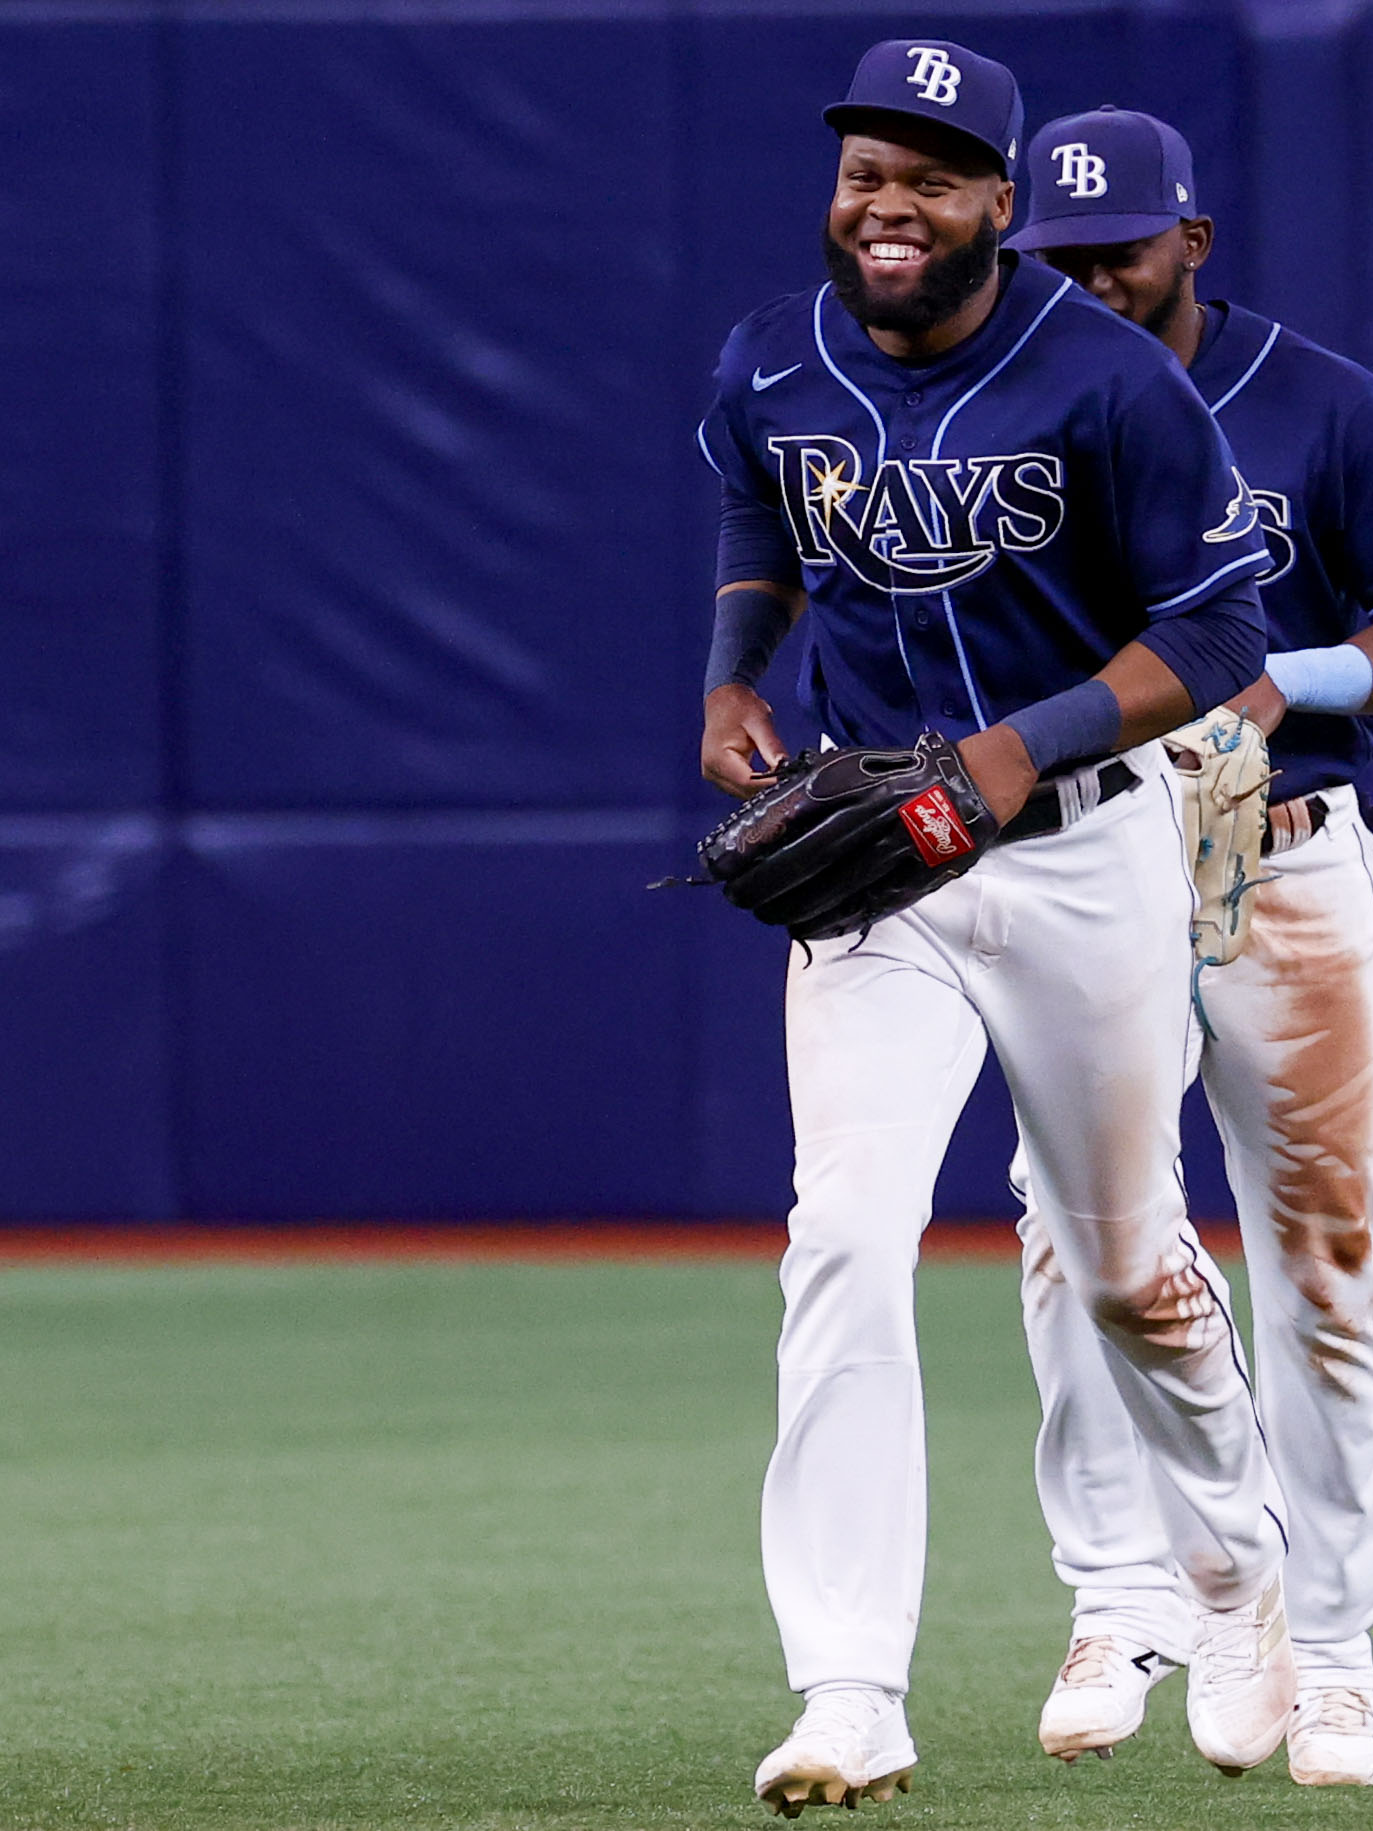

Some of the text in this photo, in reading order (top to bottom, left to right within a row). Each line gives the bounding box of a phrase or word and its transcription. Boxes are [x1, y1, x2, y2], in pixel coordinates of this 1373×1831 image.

[906, 47, 961, 106] TB
[1051, 143, 1107, 198] TB
[768, 435, 1064, 594] RAYS
[914, 804, 957, 854] Rawlings
